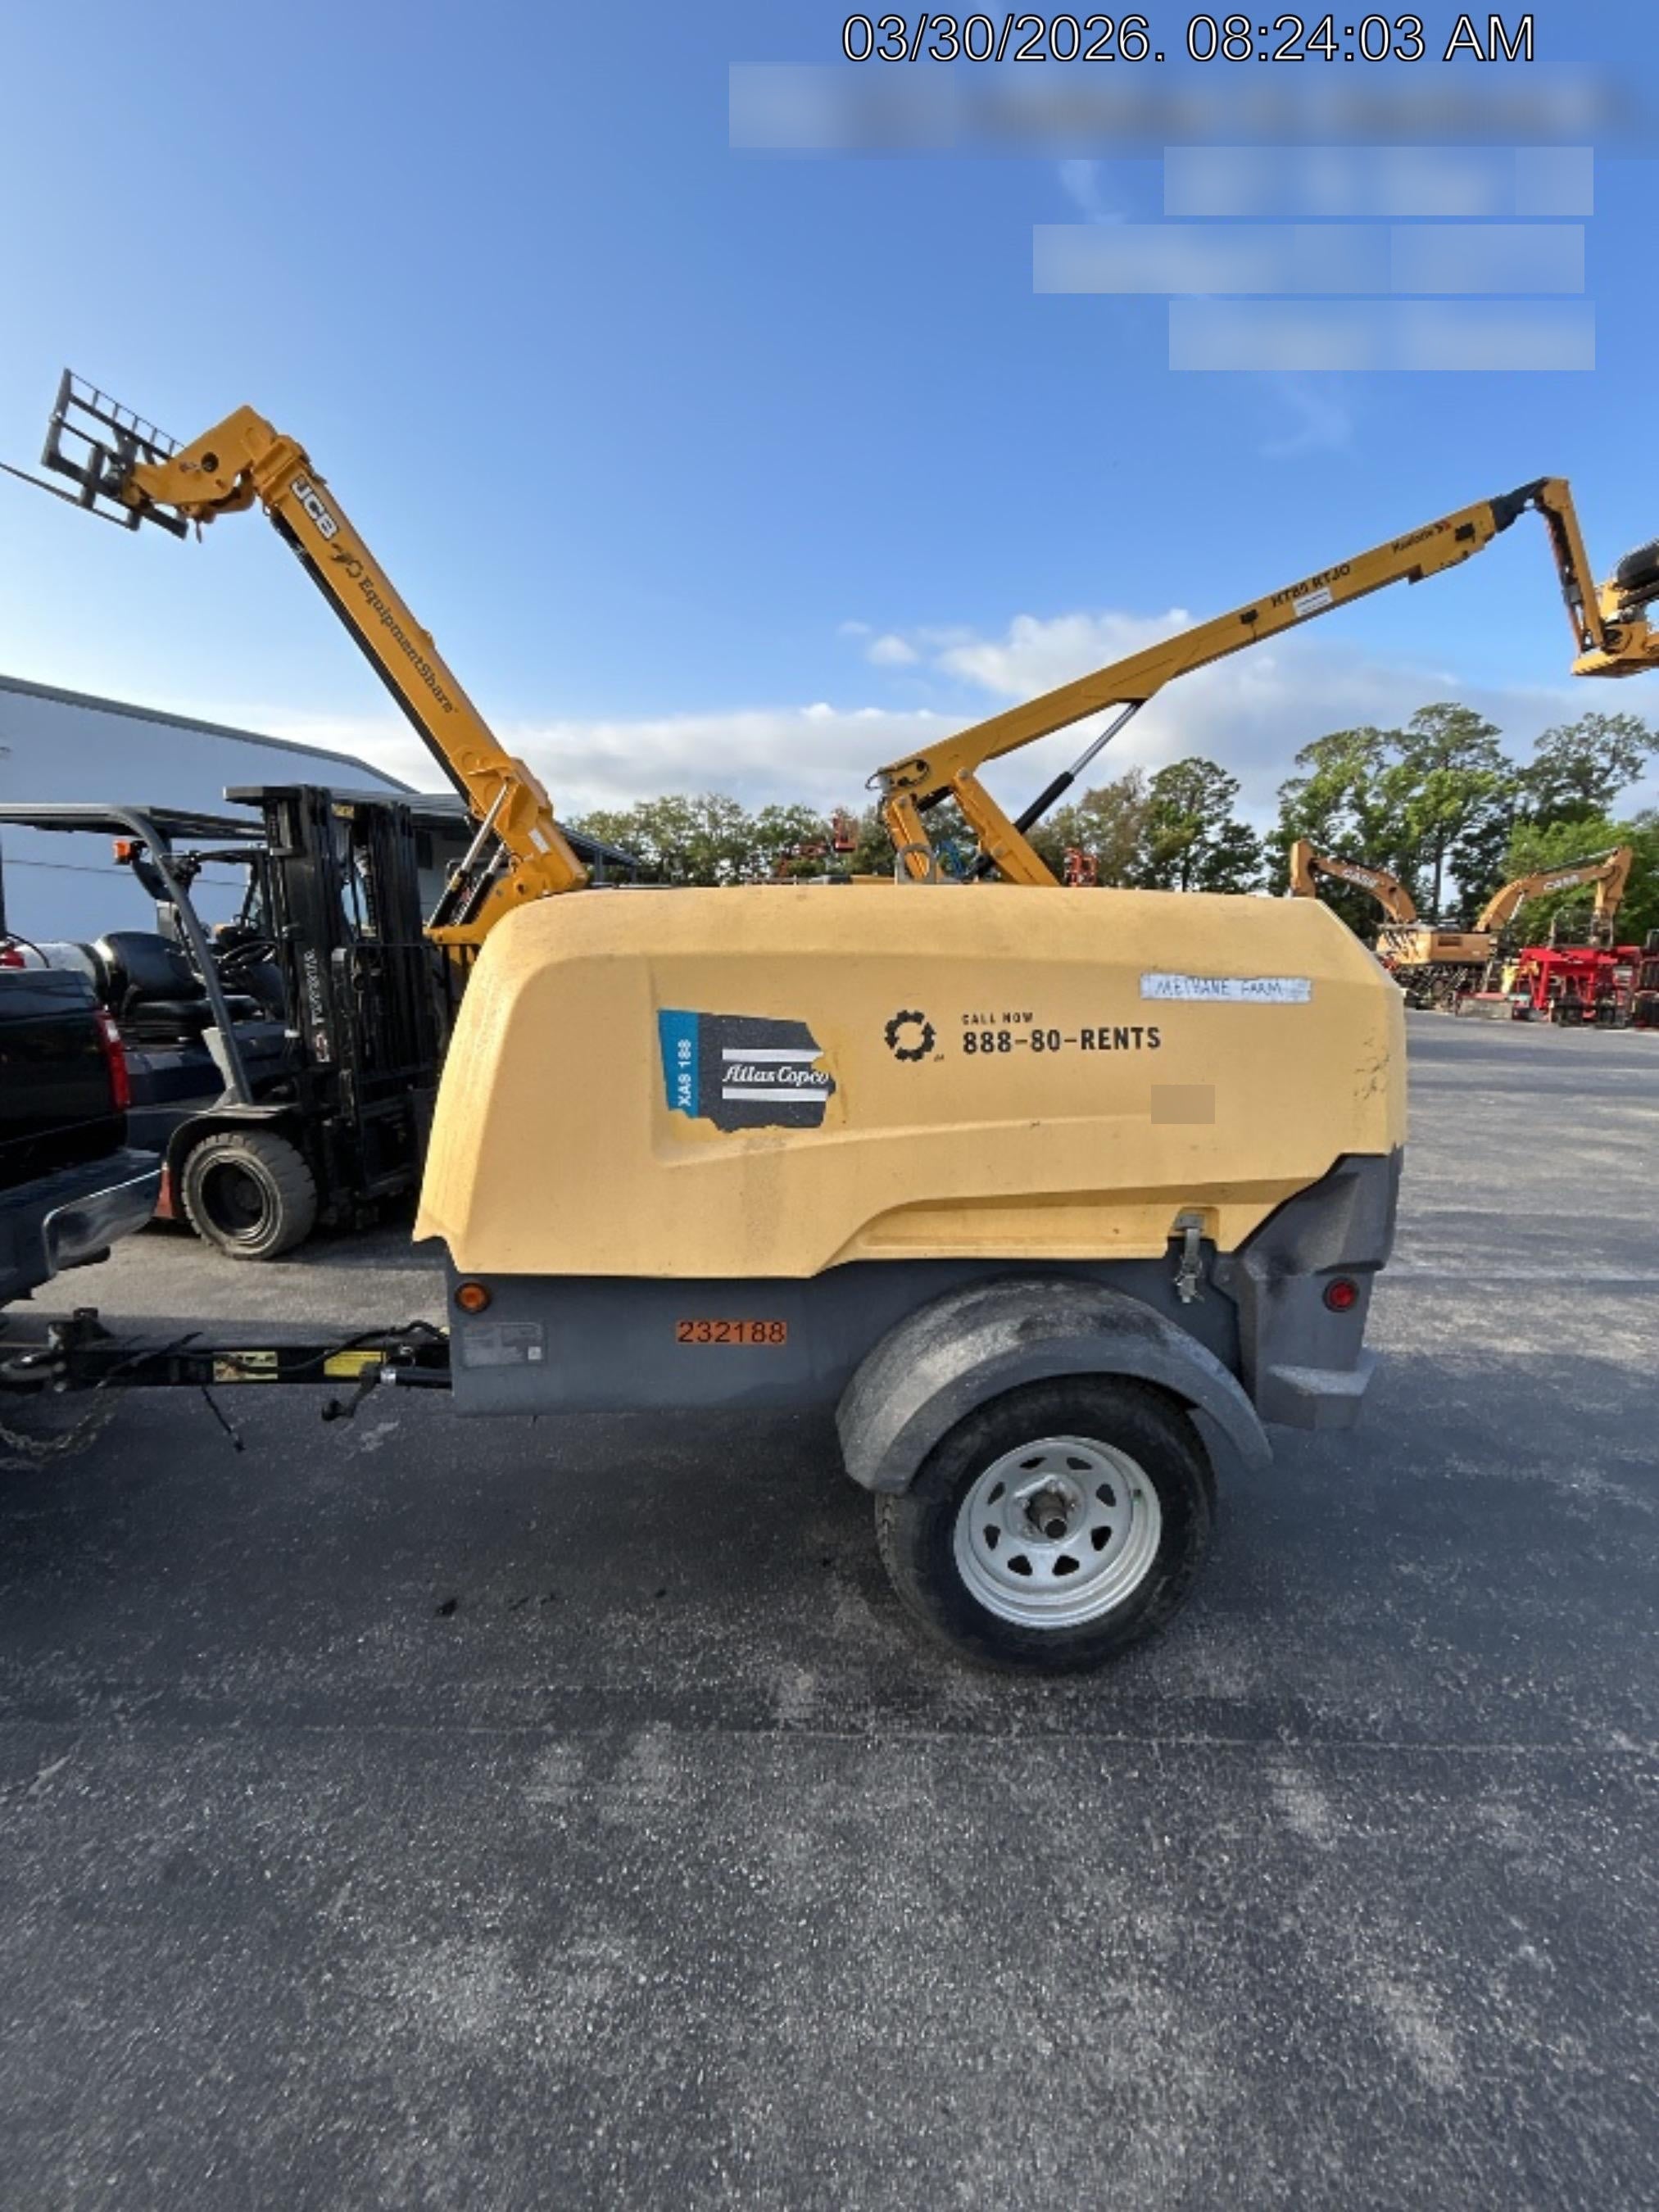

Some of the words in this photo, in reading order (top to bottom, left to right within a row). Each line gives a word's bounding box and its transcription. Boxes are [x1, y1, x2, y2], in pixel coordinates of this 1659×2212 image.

[291, 478, 338, 540] JCB
[359, 577, 453, 714] EquipmentShare
[961, 1013, 997, 1025] CALL
[1002, 1012, 1034, 1024] NOW
[678, 1038, 691, 1067] 188
[963, 1027, 1161, 1055] 888-80-RENTS
[722, 1063, 775, 1083] Atlas
[777, 1065, 830, 1086] Copco
[678, 1073, 691, 1107] XAS
[678, 1321, 785, 1343] 232188
